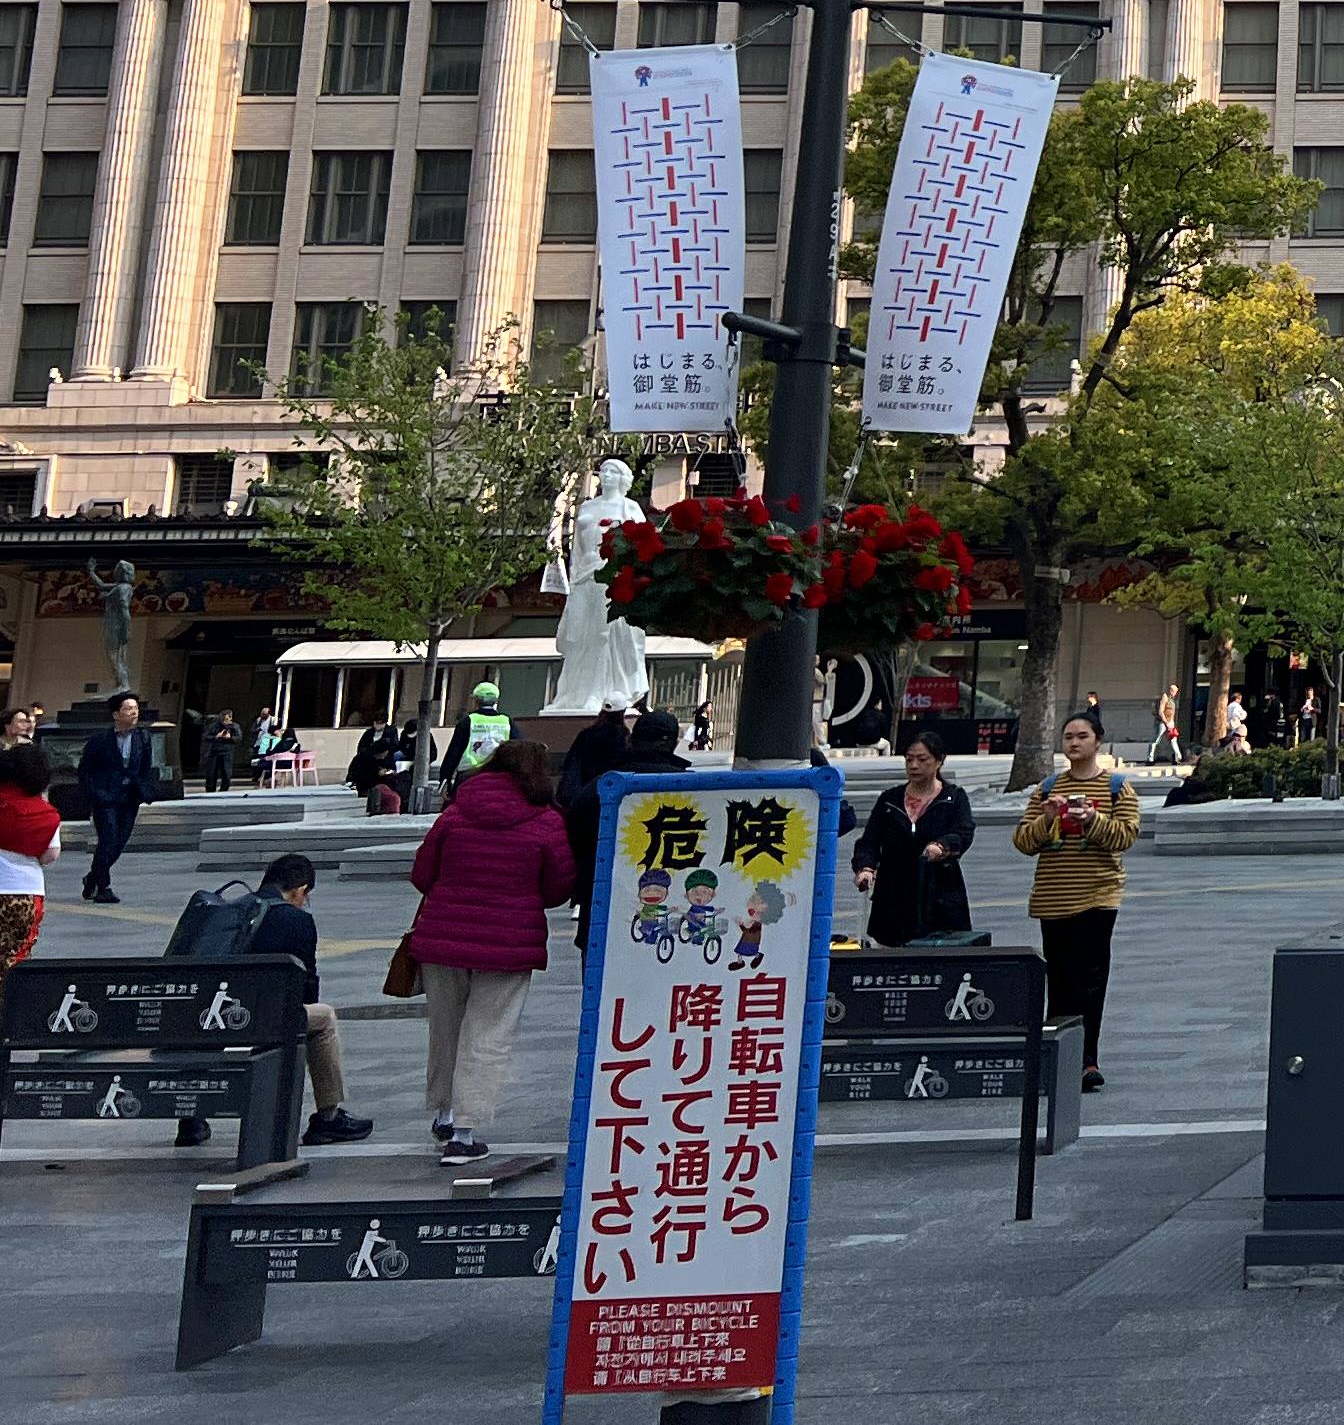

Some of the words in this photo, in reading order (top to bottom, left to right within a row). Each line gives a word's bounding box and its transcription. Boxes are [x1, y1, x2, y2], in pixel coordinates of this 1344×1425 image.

[641, 796, 794, 871] 危険
[581, 995, 656, 1297] して下さい
[649, 982, 725, 1266] 降りて通行
[720, 970, 788, 1237] 自転車から
[589, 1320, 636, 1335] FROM
[641, 1318, 685, 1333] YOUR
[691, 1314, 760, 1331] BICYCLE
[598, 1303, 661, 1319] PLEASE
[665, 1299, 753, 1317] DISMOUNT
